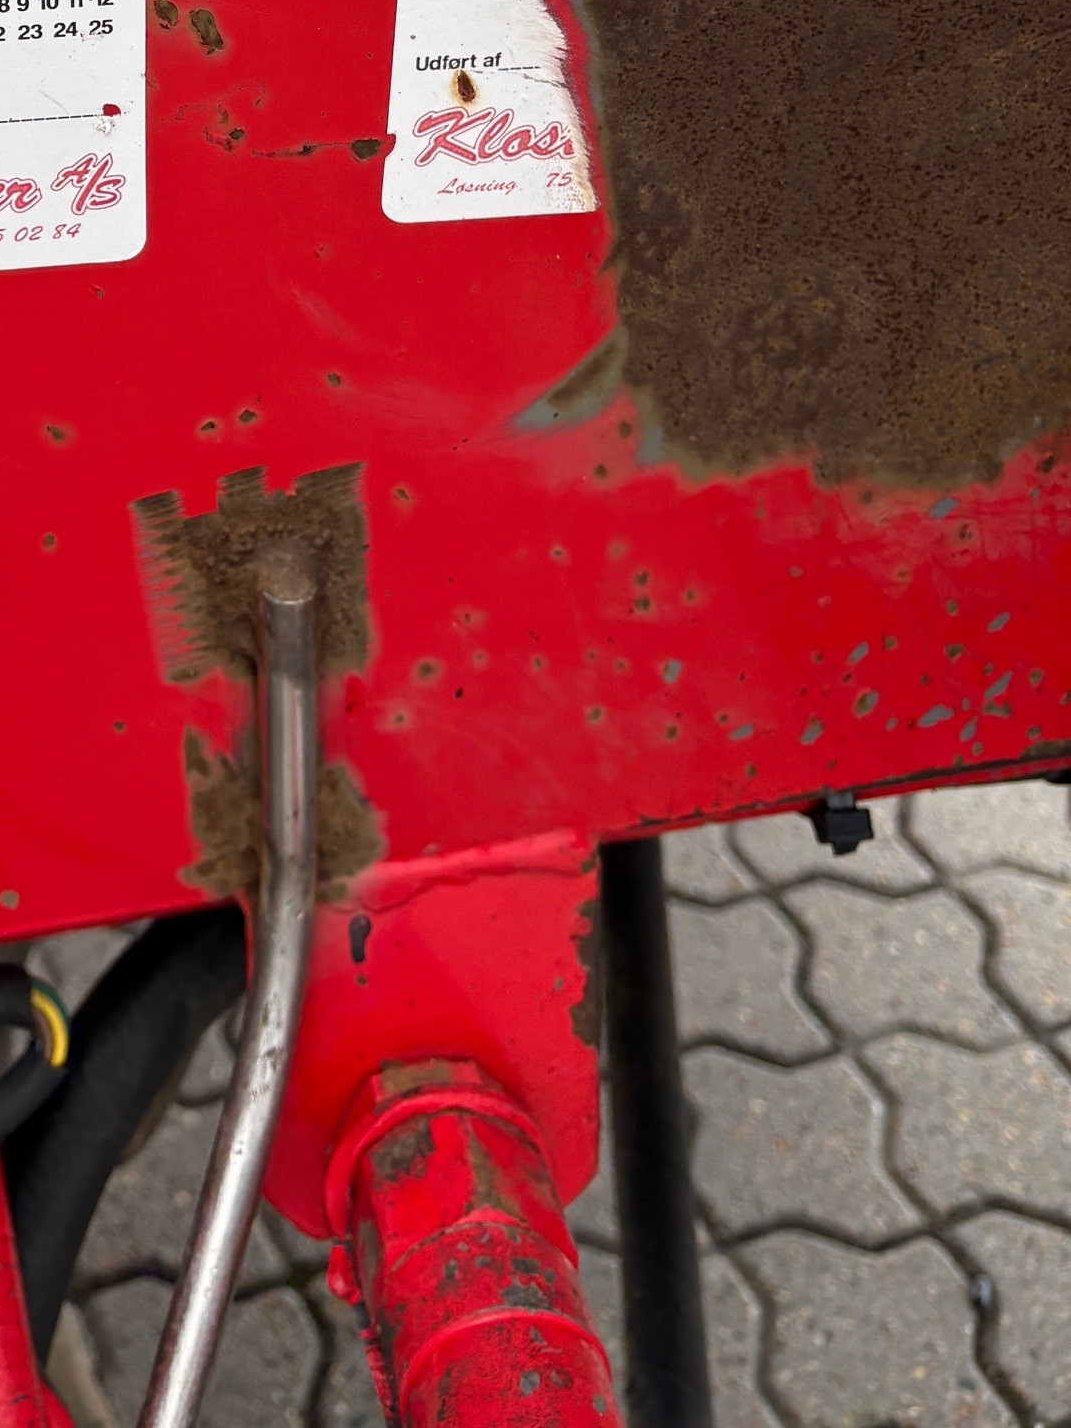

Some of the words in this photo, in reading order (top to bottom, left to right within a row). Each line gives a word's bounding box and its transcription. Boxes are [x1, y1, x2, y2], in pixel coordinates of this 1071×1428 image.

[17, 24, 42, 40] 23
[53, 22, 78, 38] 24
[88, 19, 114, 35] 25
[416, 52, 476, 71] Udført
[483, 52, 502, 68] af
[51, 152, 125, 216] A/S
[437, 179, 517, 196] Løsning
[546, 172, 572, 188] 75
[14, 225, 43, 241] 02
[52, 223, 81, 239] 84
